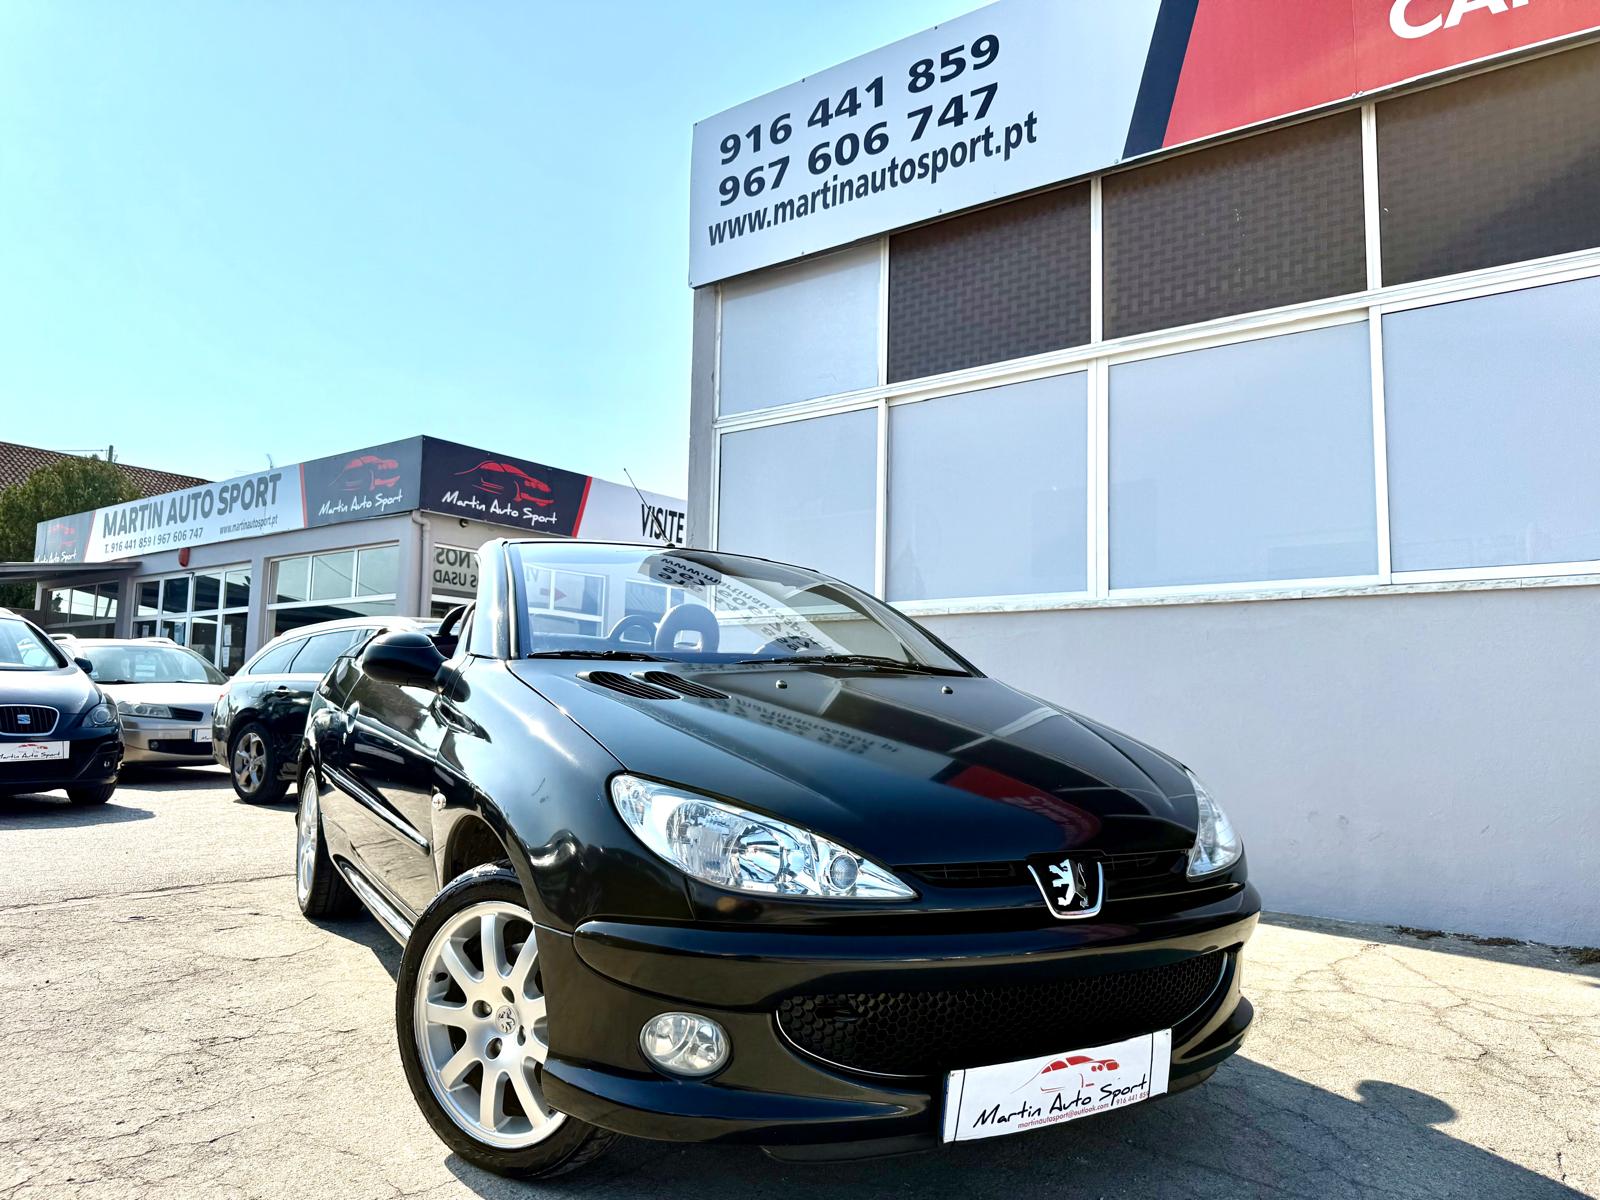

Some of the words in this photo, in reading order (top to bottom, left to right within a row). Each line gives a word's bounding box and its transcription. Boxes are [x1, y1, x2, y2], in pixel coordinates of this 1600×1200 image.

[1389, 0, 1529, 39] CA
[720, 113, 792, 165] 916
[807, 76, 884, 128] 441
[907, 34, 1000, 94] 859
[718, 155, 790, 206] 967
[808, 121, 889, 175] 606
[907, 82, 998, 142] 747
[708, 110, 1038, 247] www.martinautosport.pt
[103, 500, 164, 538] MARTIN
[166, 489, 214, 526] AUTO
[216, 473, 282, 516] SPORT
[318, 500, 348, 516] Martin
[350, 496, 372, 511] Auto
[375, 489, 403, 513] Sport
[441, 491, 486, 511] Martin
[490, 501, 519, 518] Auto
[523, 508, 557, 526] Sport
[111, 542, 123, 552] 916
[124, 539, 137, 549] 441
[139, 537, 152, 548] 859
[157, 533, 171, 545] 967
[173, 530, 187, 542] 606
[189, 527, 204, 540] 747
[641, 503, 685, 543] VISITE
[973, 1101, 1041, 1128] Martin
[1049, 1090, 1092, 1114] Auto
[1099, 1073, 1147, 1106] Sport
[1116, 1097, 1127, 1105] 916
